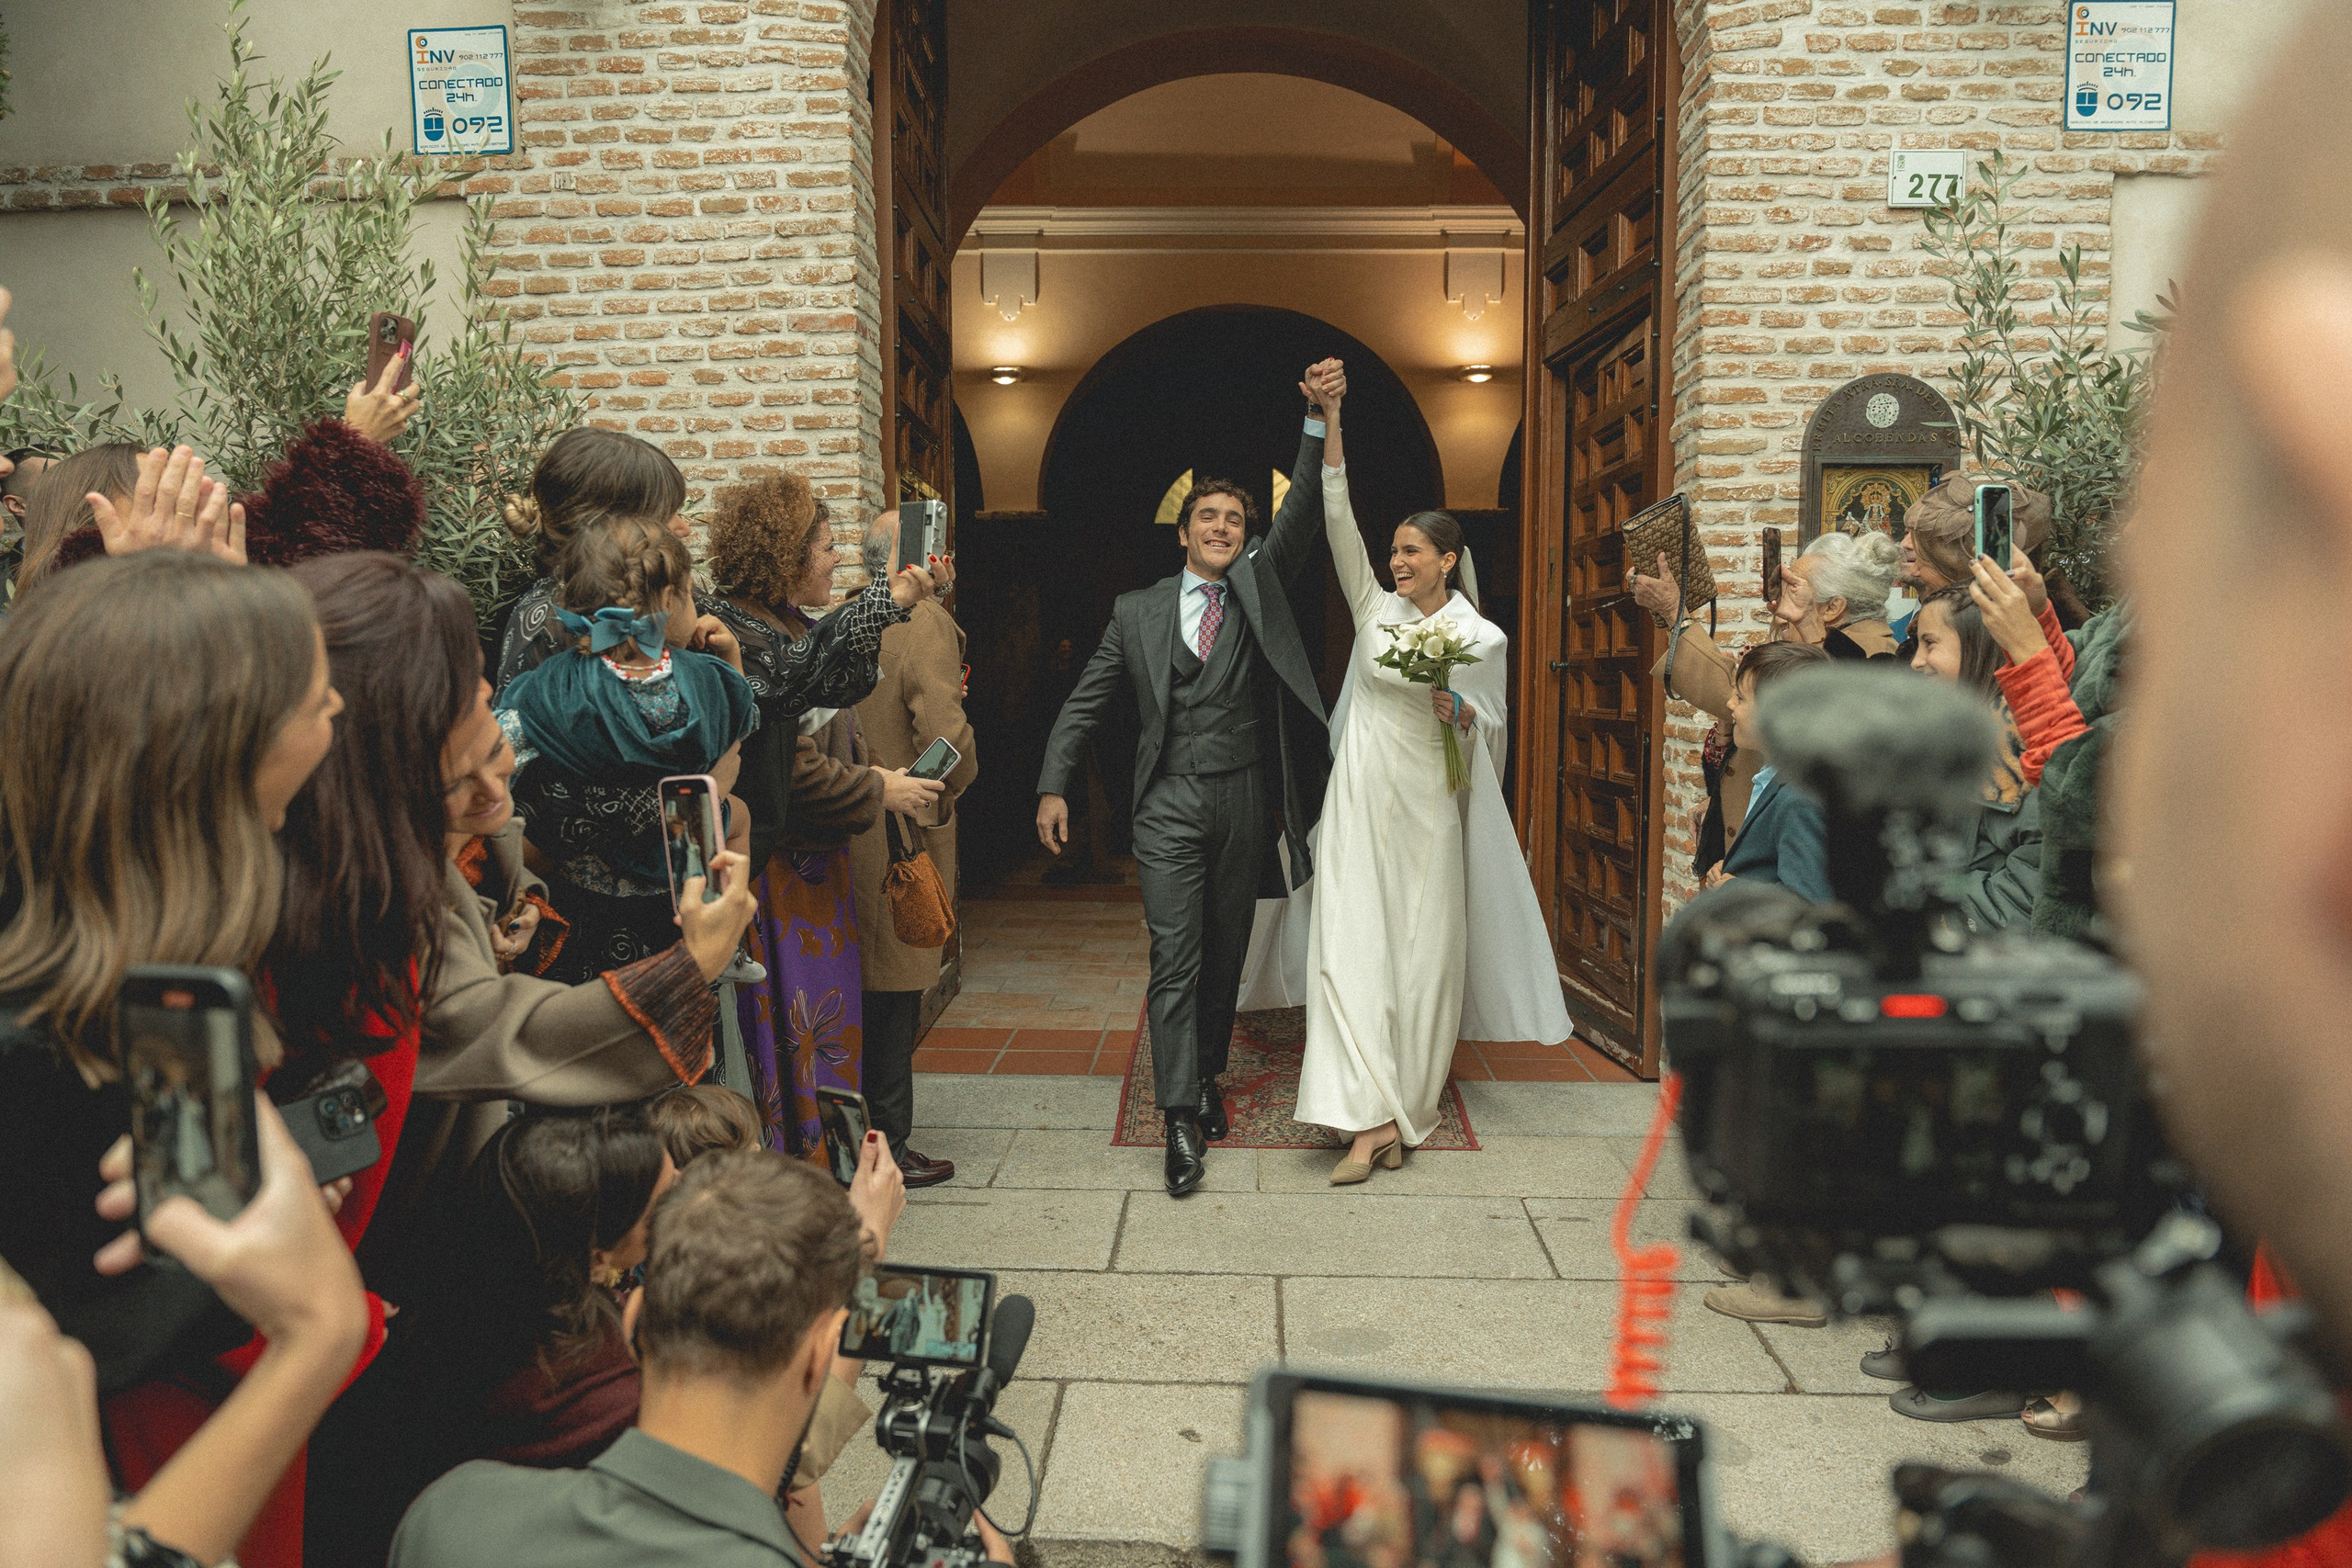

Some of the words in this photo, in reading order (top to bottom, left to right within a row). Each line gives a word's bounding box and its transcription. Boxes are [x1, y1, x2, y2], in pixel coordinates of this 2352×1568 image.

[2075, 22, 2118, 36] INV
[416, 50, 455, 64] INV
[2075, 52, 2166, 62] CONECTADO
[419, 77, 503, 90] CONECTADO
[2107, 93, 2162, 110] 092
[452, 116, 503, 134] 092
[1908, 174, 1959, 198] 277
[1813, 401, 1842, 451] ERMITA
[1833, 432, 1939, 443] ALCOBENDAS
